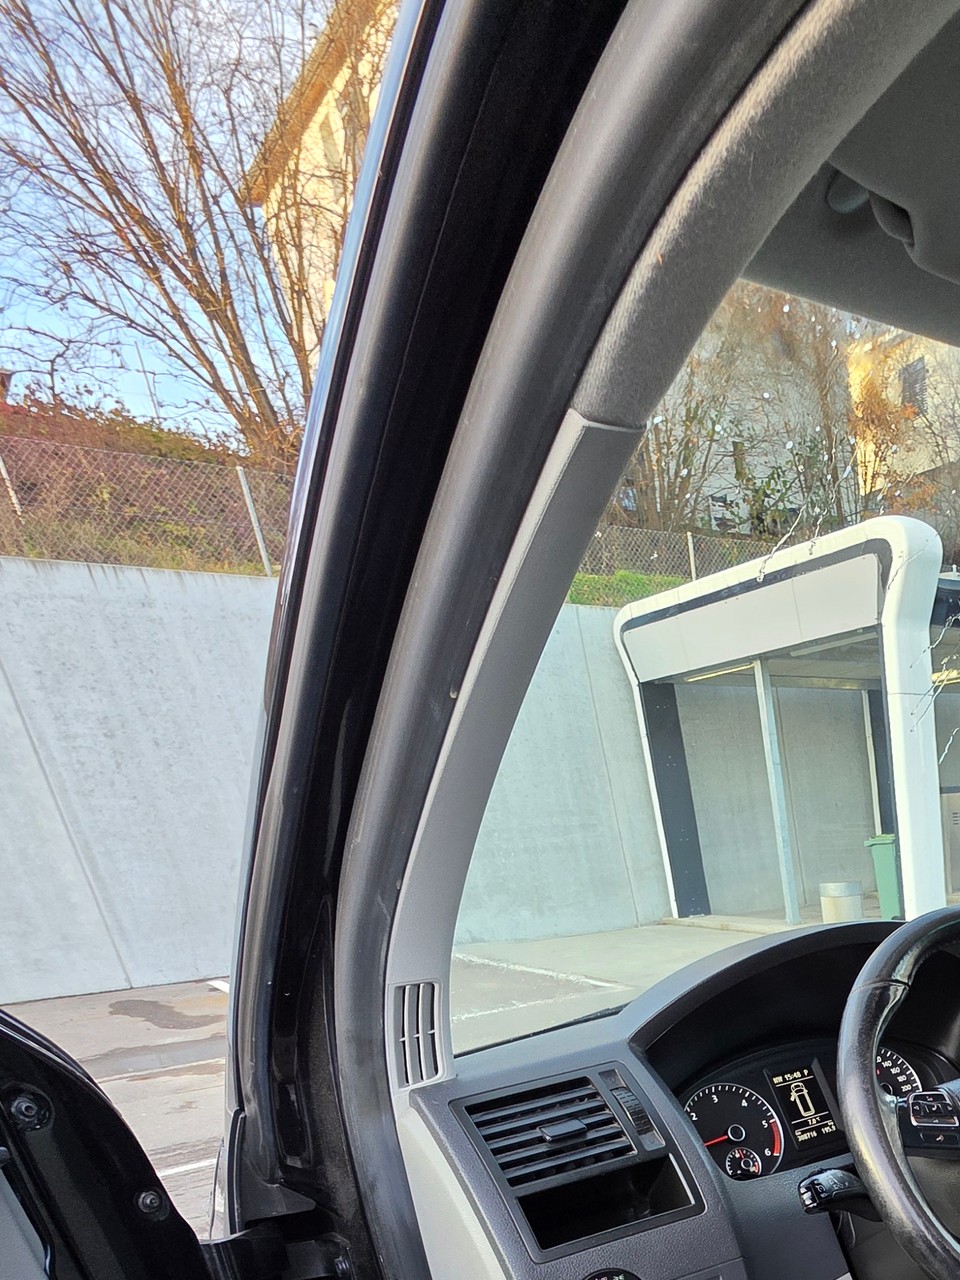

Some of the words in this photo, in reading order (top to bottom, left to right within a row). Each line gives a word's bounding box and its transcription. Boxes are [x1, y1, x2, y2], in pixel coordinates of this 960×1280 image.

[882, 1060, 892, 1068] 140
[890, 1066, 900, 1074] 160
[897, 1074, 907, 1082] 180
[901, 1084, 912, 1092] 200
[711, 1095, 719, 1103] 3
[741, 1099, 748, 1107] 4
[690, 1112, 698, 1121] 2
[761, 1120, 768, 1128] 5
[764, 1148, 771, 1157] 6
